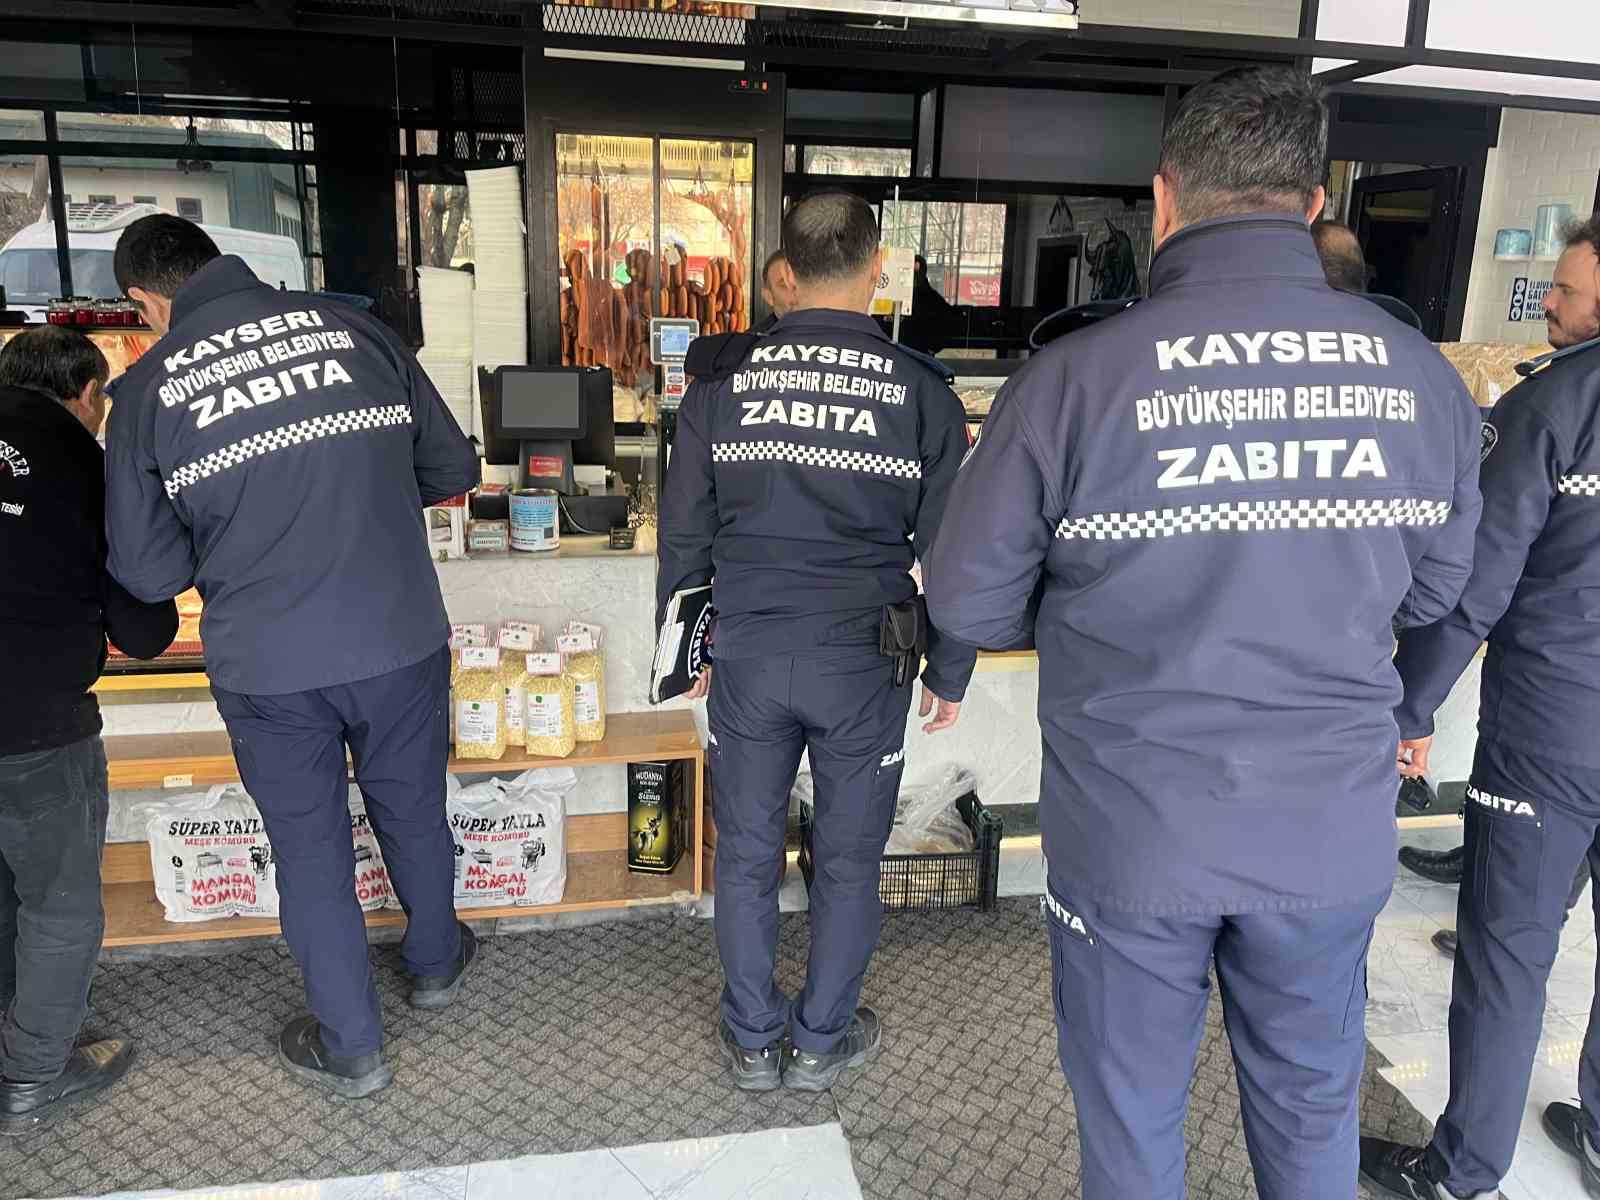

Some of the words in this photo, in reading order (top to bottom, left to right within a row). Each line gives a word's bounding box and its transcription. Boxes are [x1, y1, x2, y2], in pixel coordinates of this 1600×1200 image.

[158, 349, 265, 408] BÜYÜKŞEHİR
[261, 330, 355, 365] BELEDİYESİ
[1155, 330, 1390, 371] KAYSERİ
[188, 359, 353, 430] ZABITA
[732, 367, 820, 394] BÜYÜKŞEHİR
[823, 372, 908, 406] BELEDİYESİ
[740, 399, 878, 437] ZABITA
[1135, 385, 1287, 432] BÜYÜKŞEHİR
[1293, 384, 1416, 422] BELEDİYESİ
[1156, 438, 1388, 489] ZABITA
[1467, 784, 1536, 816] ZABITA
[168, 817, 221, 836] SÜPER
[224, 818, 264, 835] YAYL
[191, 873, 256, 891] MANGAL
[192, 885, 257, 906] KÖMÜRÜ
[1046, 888, 1087, 935] BITA
